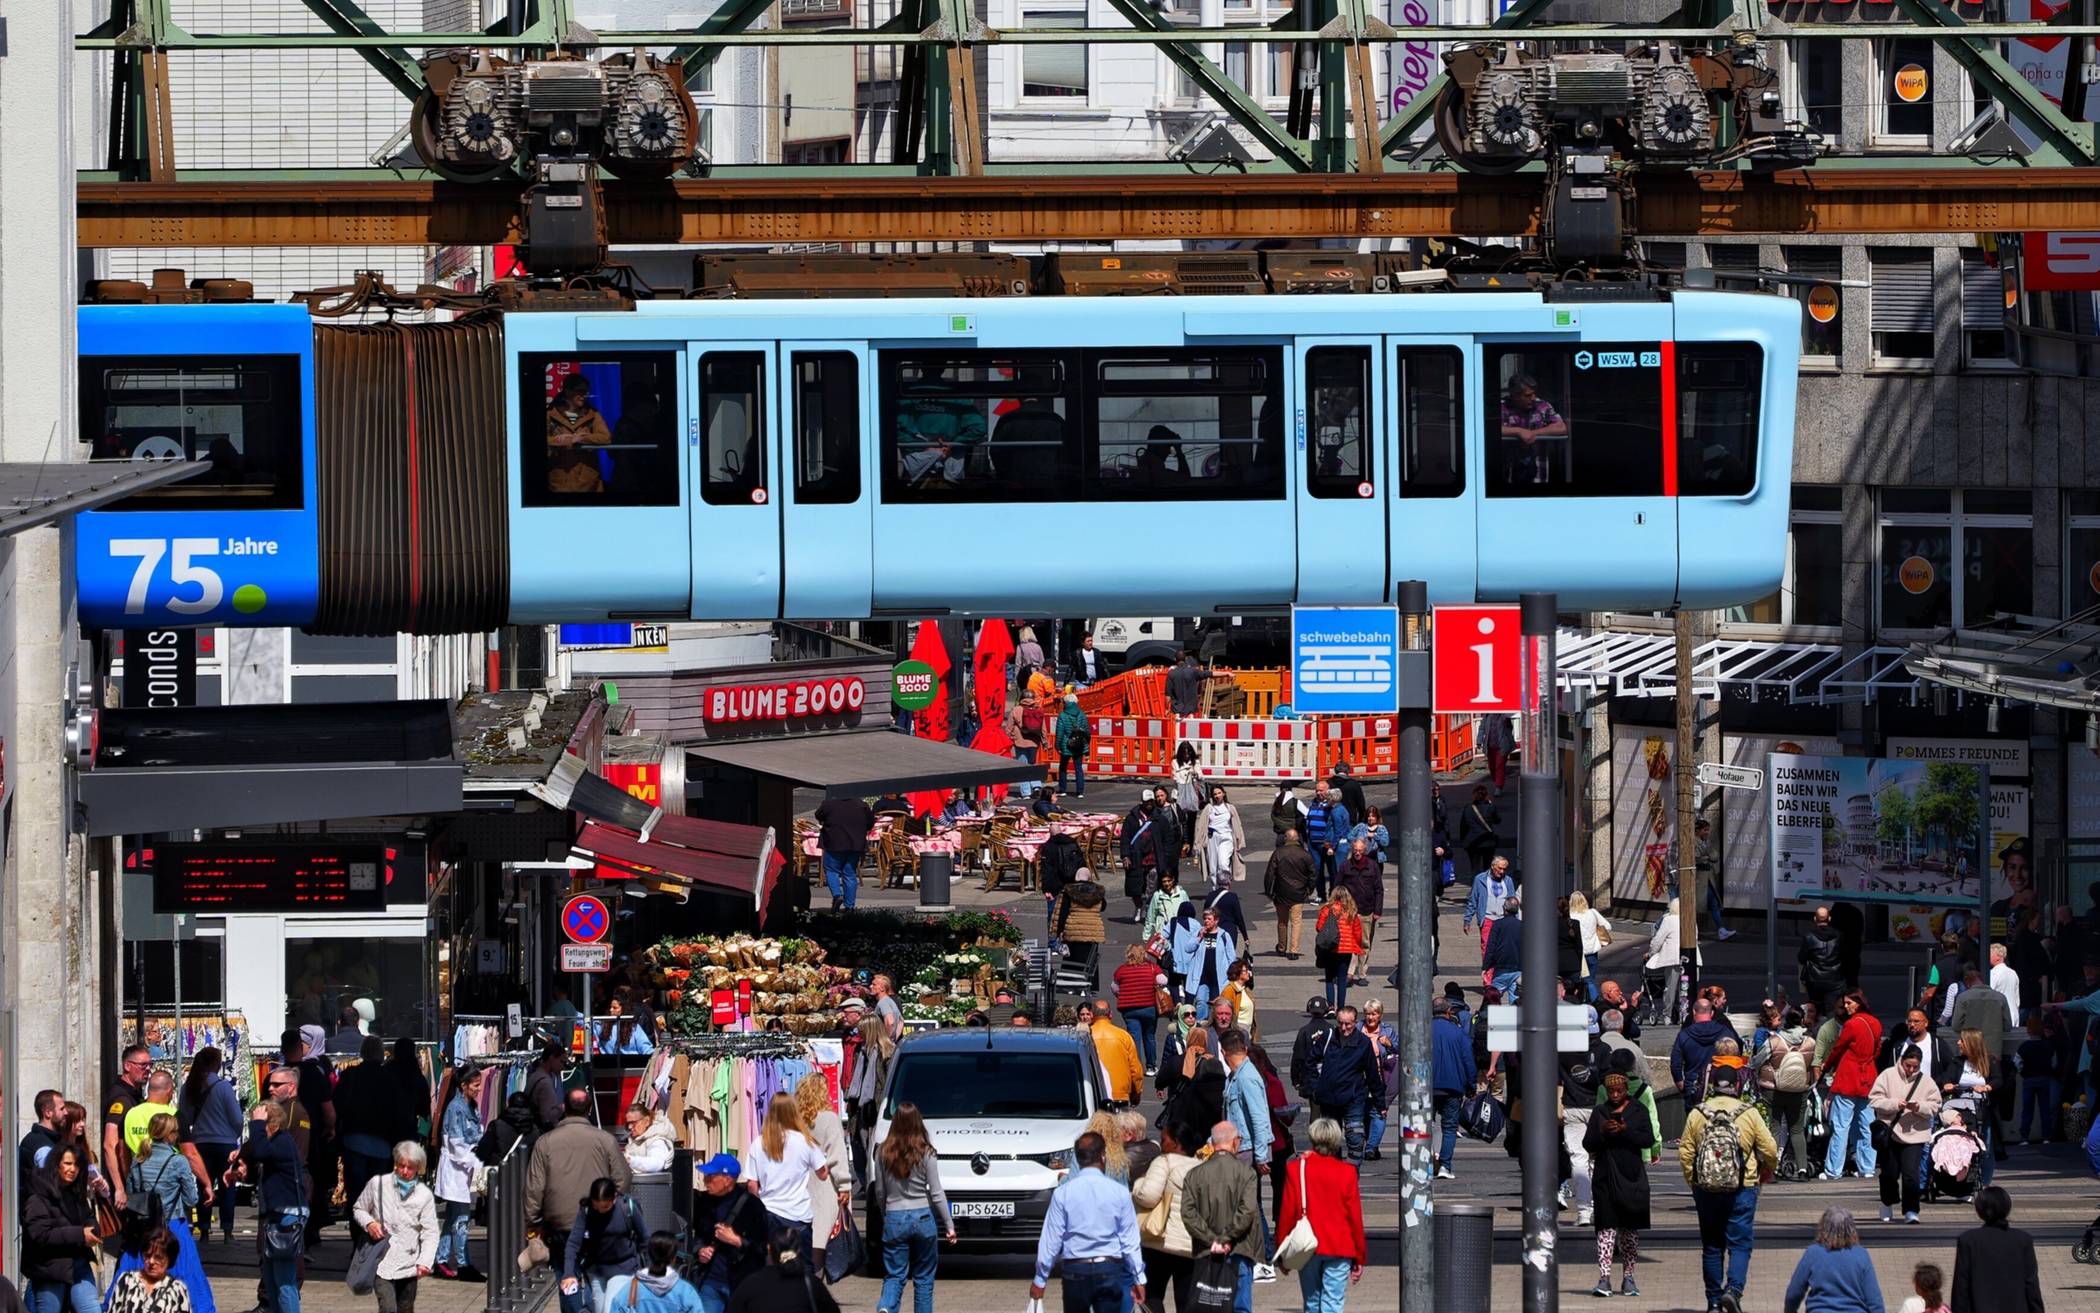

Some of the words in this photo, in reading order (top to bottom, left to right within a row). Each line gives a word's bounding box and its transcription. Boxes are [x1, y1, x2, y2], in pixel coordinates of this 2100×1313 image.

[1643, 354, 1657, 364] 28
[109, 538, 224, 615] 75
[223, 537, 279, 555] Jahre
[1299, 631, 1391, 643] schwebebahn
[896, 673, 931, 685] BLUME
[899, 683, 930, 693] 2000
[711, 686, 788, 720] BLUME
[793, 681, 864, 714] 2000
[1958, 747, 2020, 761] FREUNDE
[1776, 767, 1840, 782] ZUSAMMEN
[1777, 783, 1813, 797] BAUEN
[1816, 785, 1838, 798] WIR
[1989, 791, 2024, 804] WANT
[1777, 799, 1798, 811] DAS
[1801, 801, 1831, 813] NEUE
[1777, 814, 1835, 829] ELBERFELD
[565, 948, 605, 957] Rettungsweg
[953, 1204, 960, 1215] D
[967, 1204, 981, 1215] PS
[984, 1204, 1013, 1215] 624E
